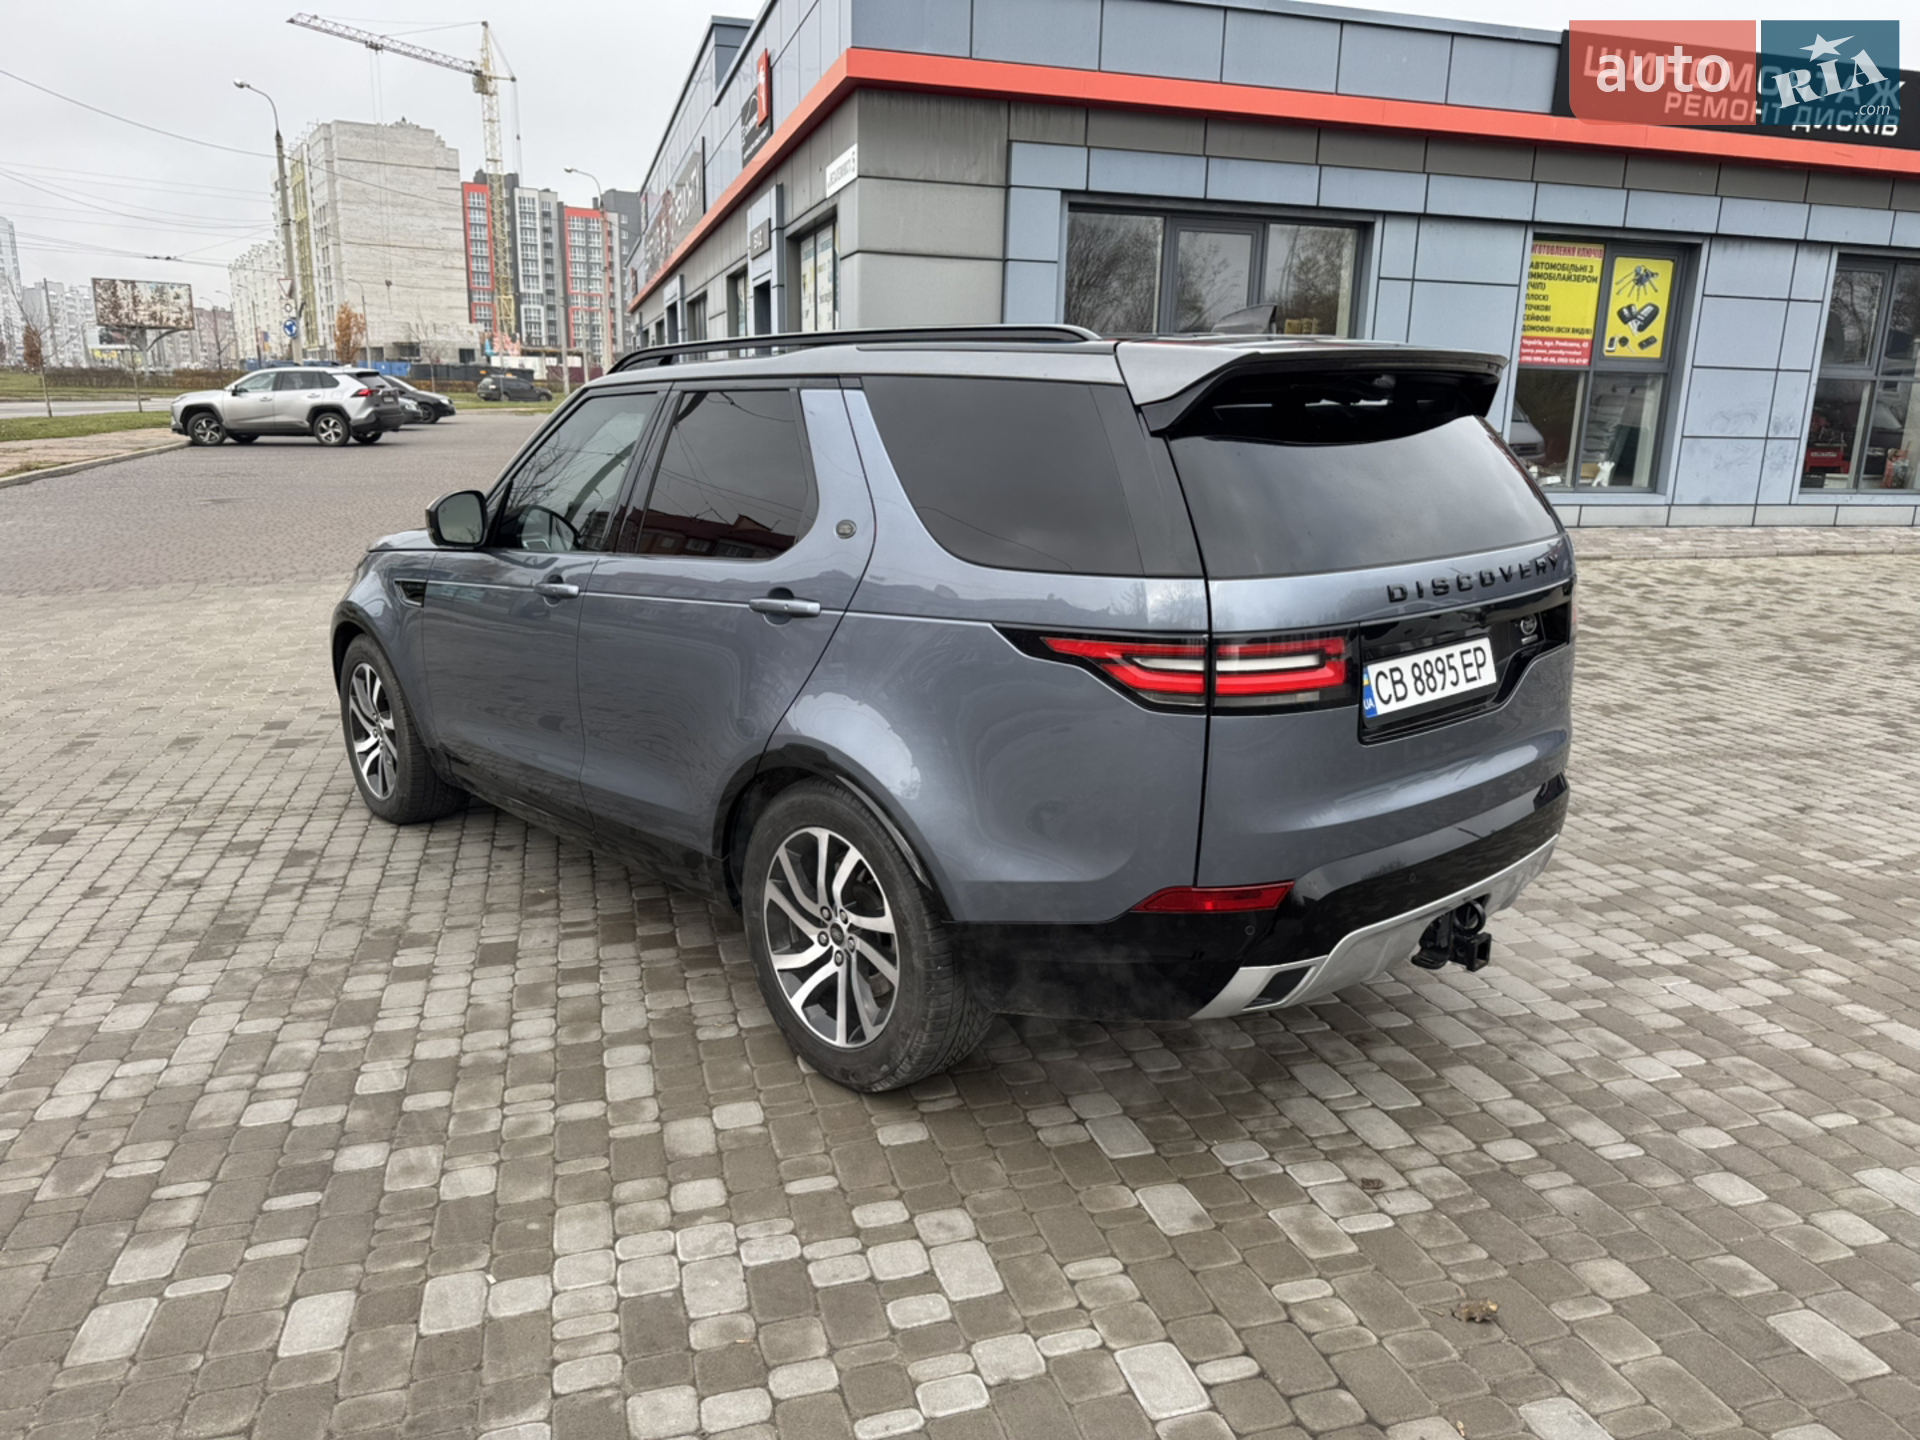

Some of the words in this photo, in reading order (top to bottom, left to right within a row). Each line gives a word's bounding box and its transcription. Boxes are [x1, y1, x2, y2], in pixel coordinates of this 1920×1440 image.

[1664, 91, 1784, 125] РЕМОНТ
[1791, 105, 1900, 137] ДИСКІВ
[1529, 262, 1588, 273] АВТОМОБІЛЬНІ
[1386, 555, 1559, 602] DISCOVERY
[1375, 666, 1409, 706] CB
[1411, 653, 1461, 697] 8895
[1460, 646, 1488, 684] EP
